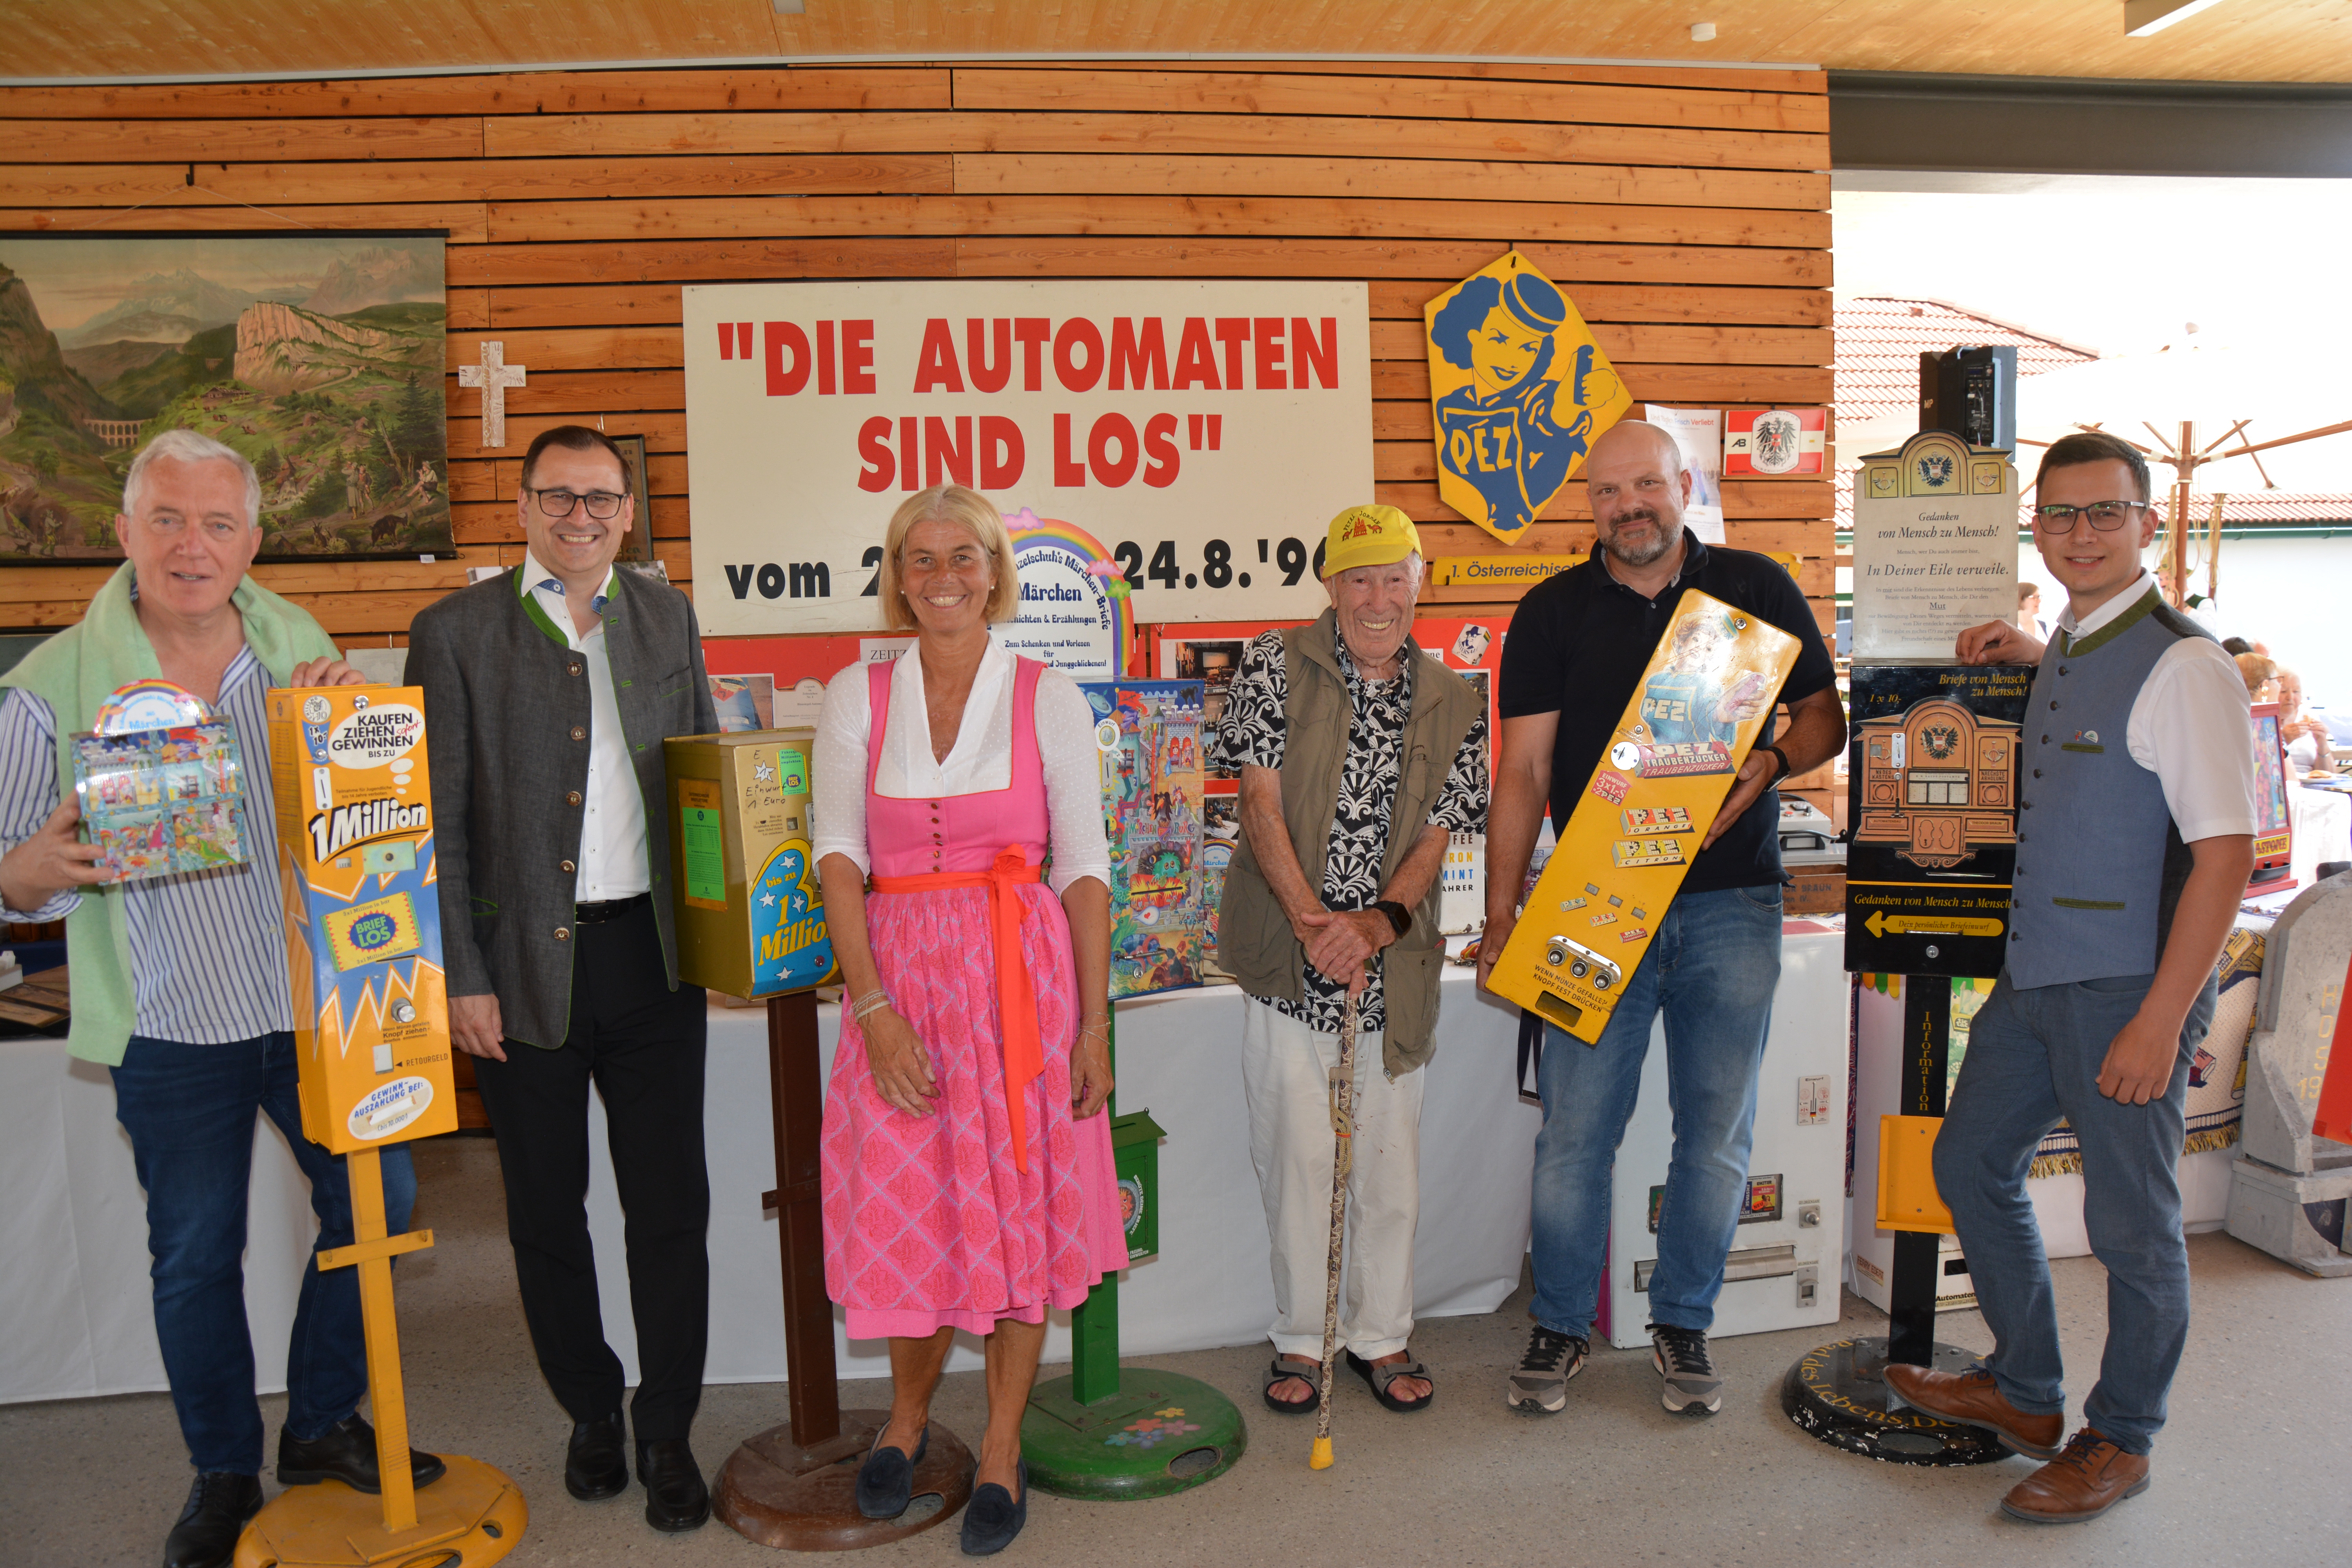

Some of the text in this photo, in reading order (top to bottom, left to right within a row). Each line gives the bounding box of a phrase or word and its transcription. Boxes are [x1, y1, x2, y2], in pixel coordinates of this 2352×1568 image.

[718, 317, 1339, 397] "DIE AUTOMATEN
[857, 413, 1223, 493] SIND LOS"
[1450, 426, 1512, 474] PEZ
[1343, 511, 1381, 530] PETRA JORDAN
[1918, 512, 1959, 522] Gedanken
[1878, 530, 1895, 539] von
[1898, 526, 1937, 539] Mensch
[1955, 525, 1998, 537] Mensch!
[1451, 561, 1576, 578] 1. Österreichisc
[1867, 563, 2009, 575] In Deiner Eile verweile.
[724, 561, 831, 600] vom
[1018, 583, 1082, 601] Märchen
[1044, 615, 1096, 626] & Erzählungen
[1056, 660, 1106, 669] Junggebliebenen!
[1939, 675, 1967, 686] Briefe
[1990, 674, 2026, 684] Mensch
[1970, 686, 2027, 696] zu Mensch!
[1641, 697, 1685, 721] PEZ
[129, 718, 175, 730] Märchen
[358, 713, 412, 726] KAUFEN
[343, 725, 395, 739] ZIEHEN
[397, 720, 421, 737] sofort
[332, 735, 413, 751] GEWINNEN
[1652, 742, 1714, 757] PEZ
[368, 750, 382, 758] BIS
[1645, 753, 1726, 767] TRAUBENZUCKER
[1644, 762, 1725, 776] TRAUBENZUCKER
[1602, 773, 1627, 788] EINWURF
[746, 782, 787, 796] Einwurf
[764, 797, 786, 806] Euro
[1628, 808, 1688, 825] PEZ
[328, 797, 427, 854] Million
[1634, 824, 1686, 833] ORANGE
[1620, 840, 1680, 857] PEZ
[1625, 857, 1678, 865] CITRON
[765, 871, 797, 888] bis zu
[354, 905, 373, 913] Million
[1562, 897, 1585, 908] PEZ
[1855, 894, 1901, 905] Gedanken
[1924, 897, 1959, 907] Mensch
[1976, 898, 2011, 909] Mensch
[777, 894, 789, 927] 1
[1592, 913, 1615, 922] PEZ
[356, 916, 386, 934] BRIEF
[1950, 922, 1990, 932] Briefeinwurf
[359, 926, 390, 947] LOS
[757, 919, 828, 966] Millio
[367, 952, 386, 961] Million
[1535, 964, 1608, 1005] WENN MÜNZE GEFALLEN
[1533, 973, 1602, 1013] KNOPF FEST DRÜCKEN
[407, 1053, 448, 1067] RETOURGELD
[1918, 1011, 1933, 1111] Information
[355, 1082, 423, 1118] AUSZAHLUNG BEI:
[1857, 1256, 1870, 1270] FERRY
[1809, 1339, 1854, 1358] Rad
[1801, 1358, 1824, 1380] des
